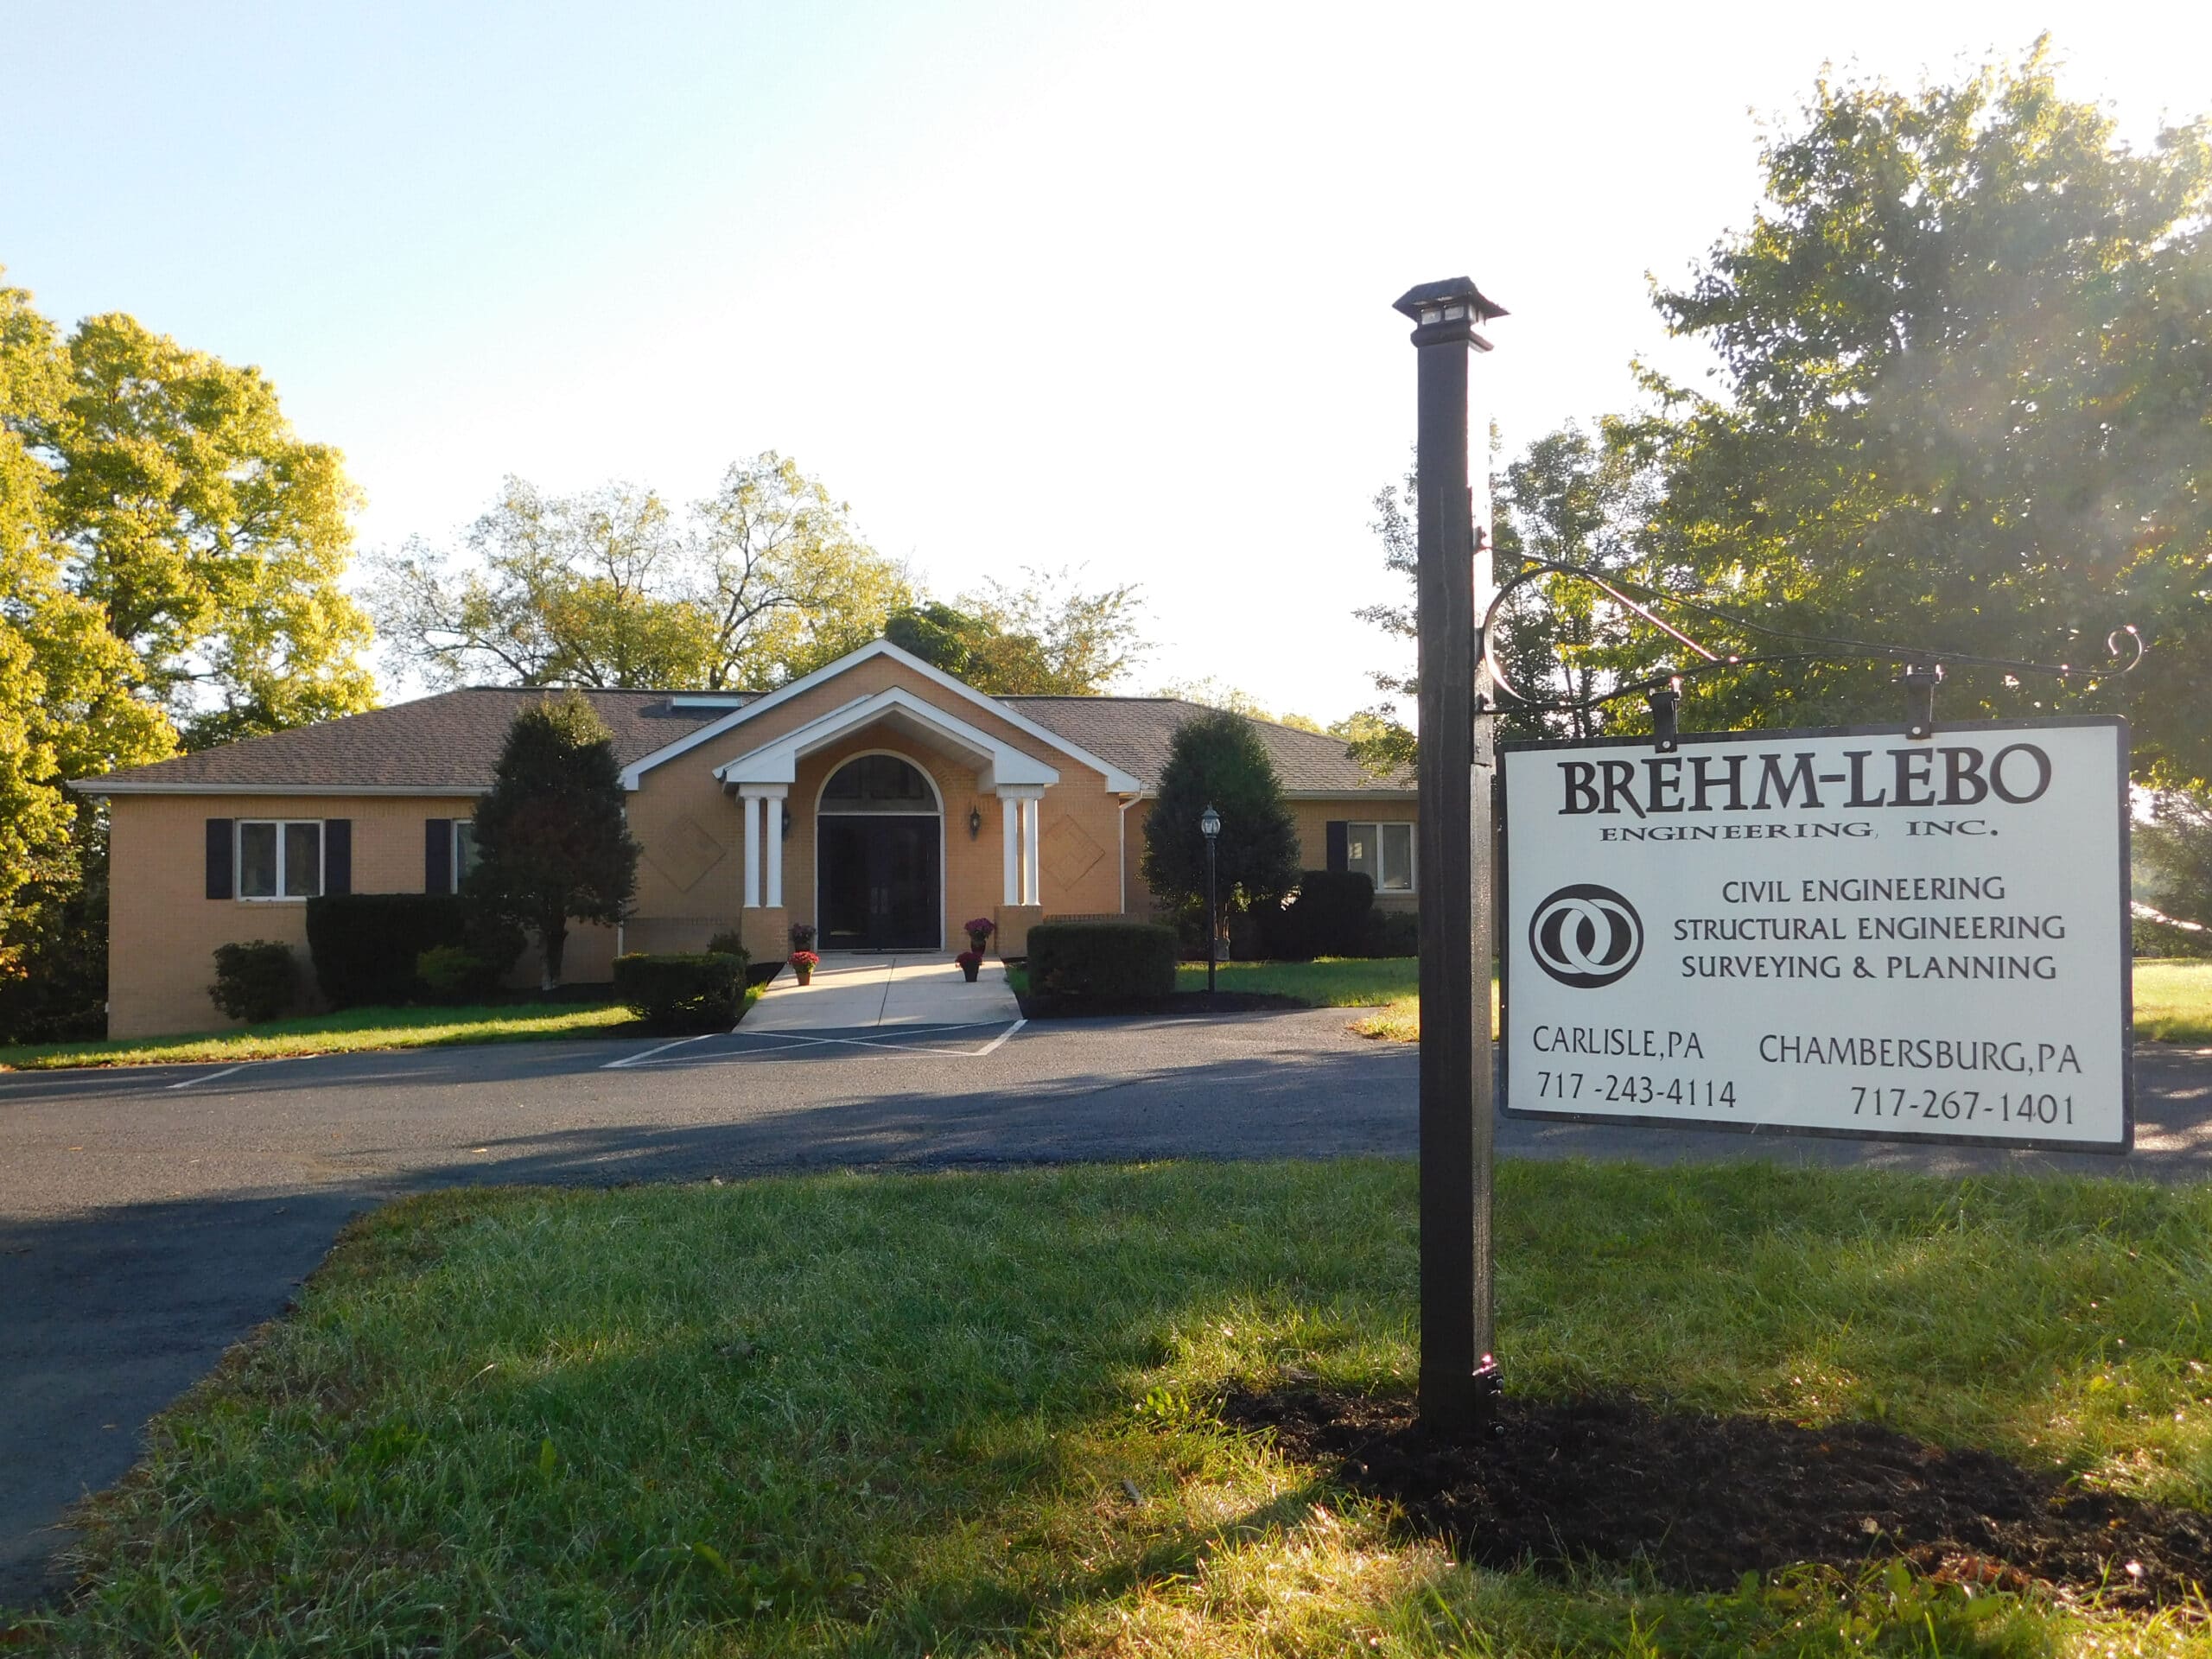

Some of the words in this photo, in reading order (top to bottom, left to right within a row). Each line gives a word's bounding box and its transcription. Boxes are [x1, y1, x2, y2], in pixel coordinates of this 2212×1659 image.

[1558, 743, 2051, 819] BREHM-LEBO
[1905, 819, 1999, 837] INC.
[1722, 880, 1791, 904] CIVIL
[1802, 875, 2005, 902] ENGINEERING
[1674, 918, 1847, 941] STRUCTURAL
[1858, 915, 2065, 940] ENGINEERING
[1681, 955, 1841, 979] SURVEYING
[1853, 956, 1878, 979] &
[1887, 955, 2056, 980] PLANNING
[1851, 1086, 2074, 1125] 717-267-1401
